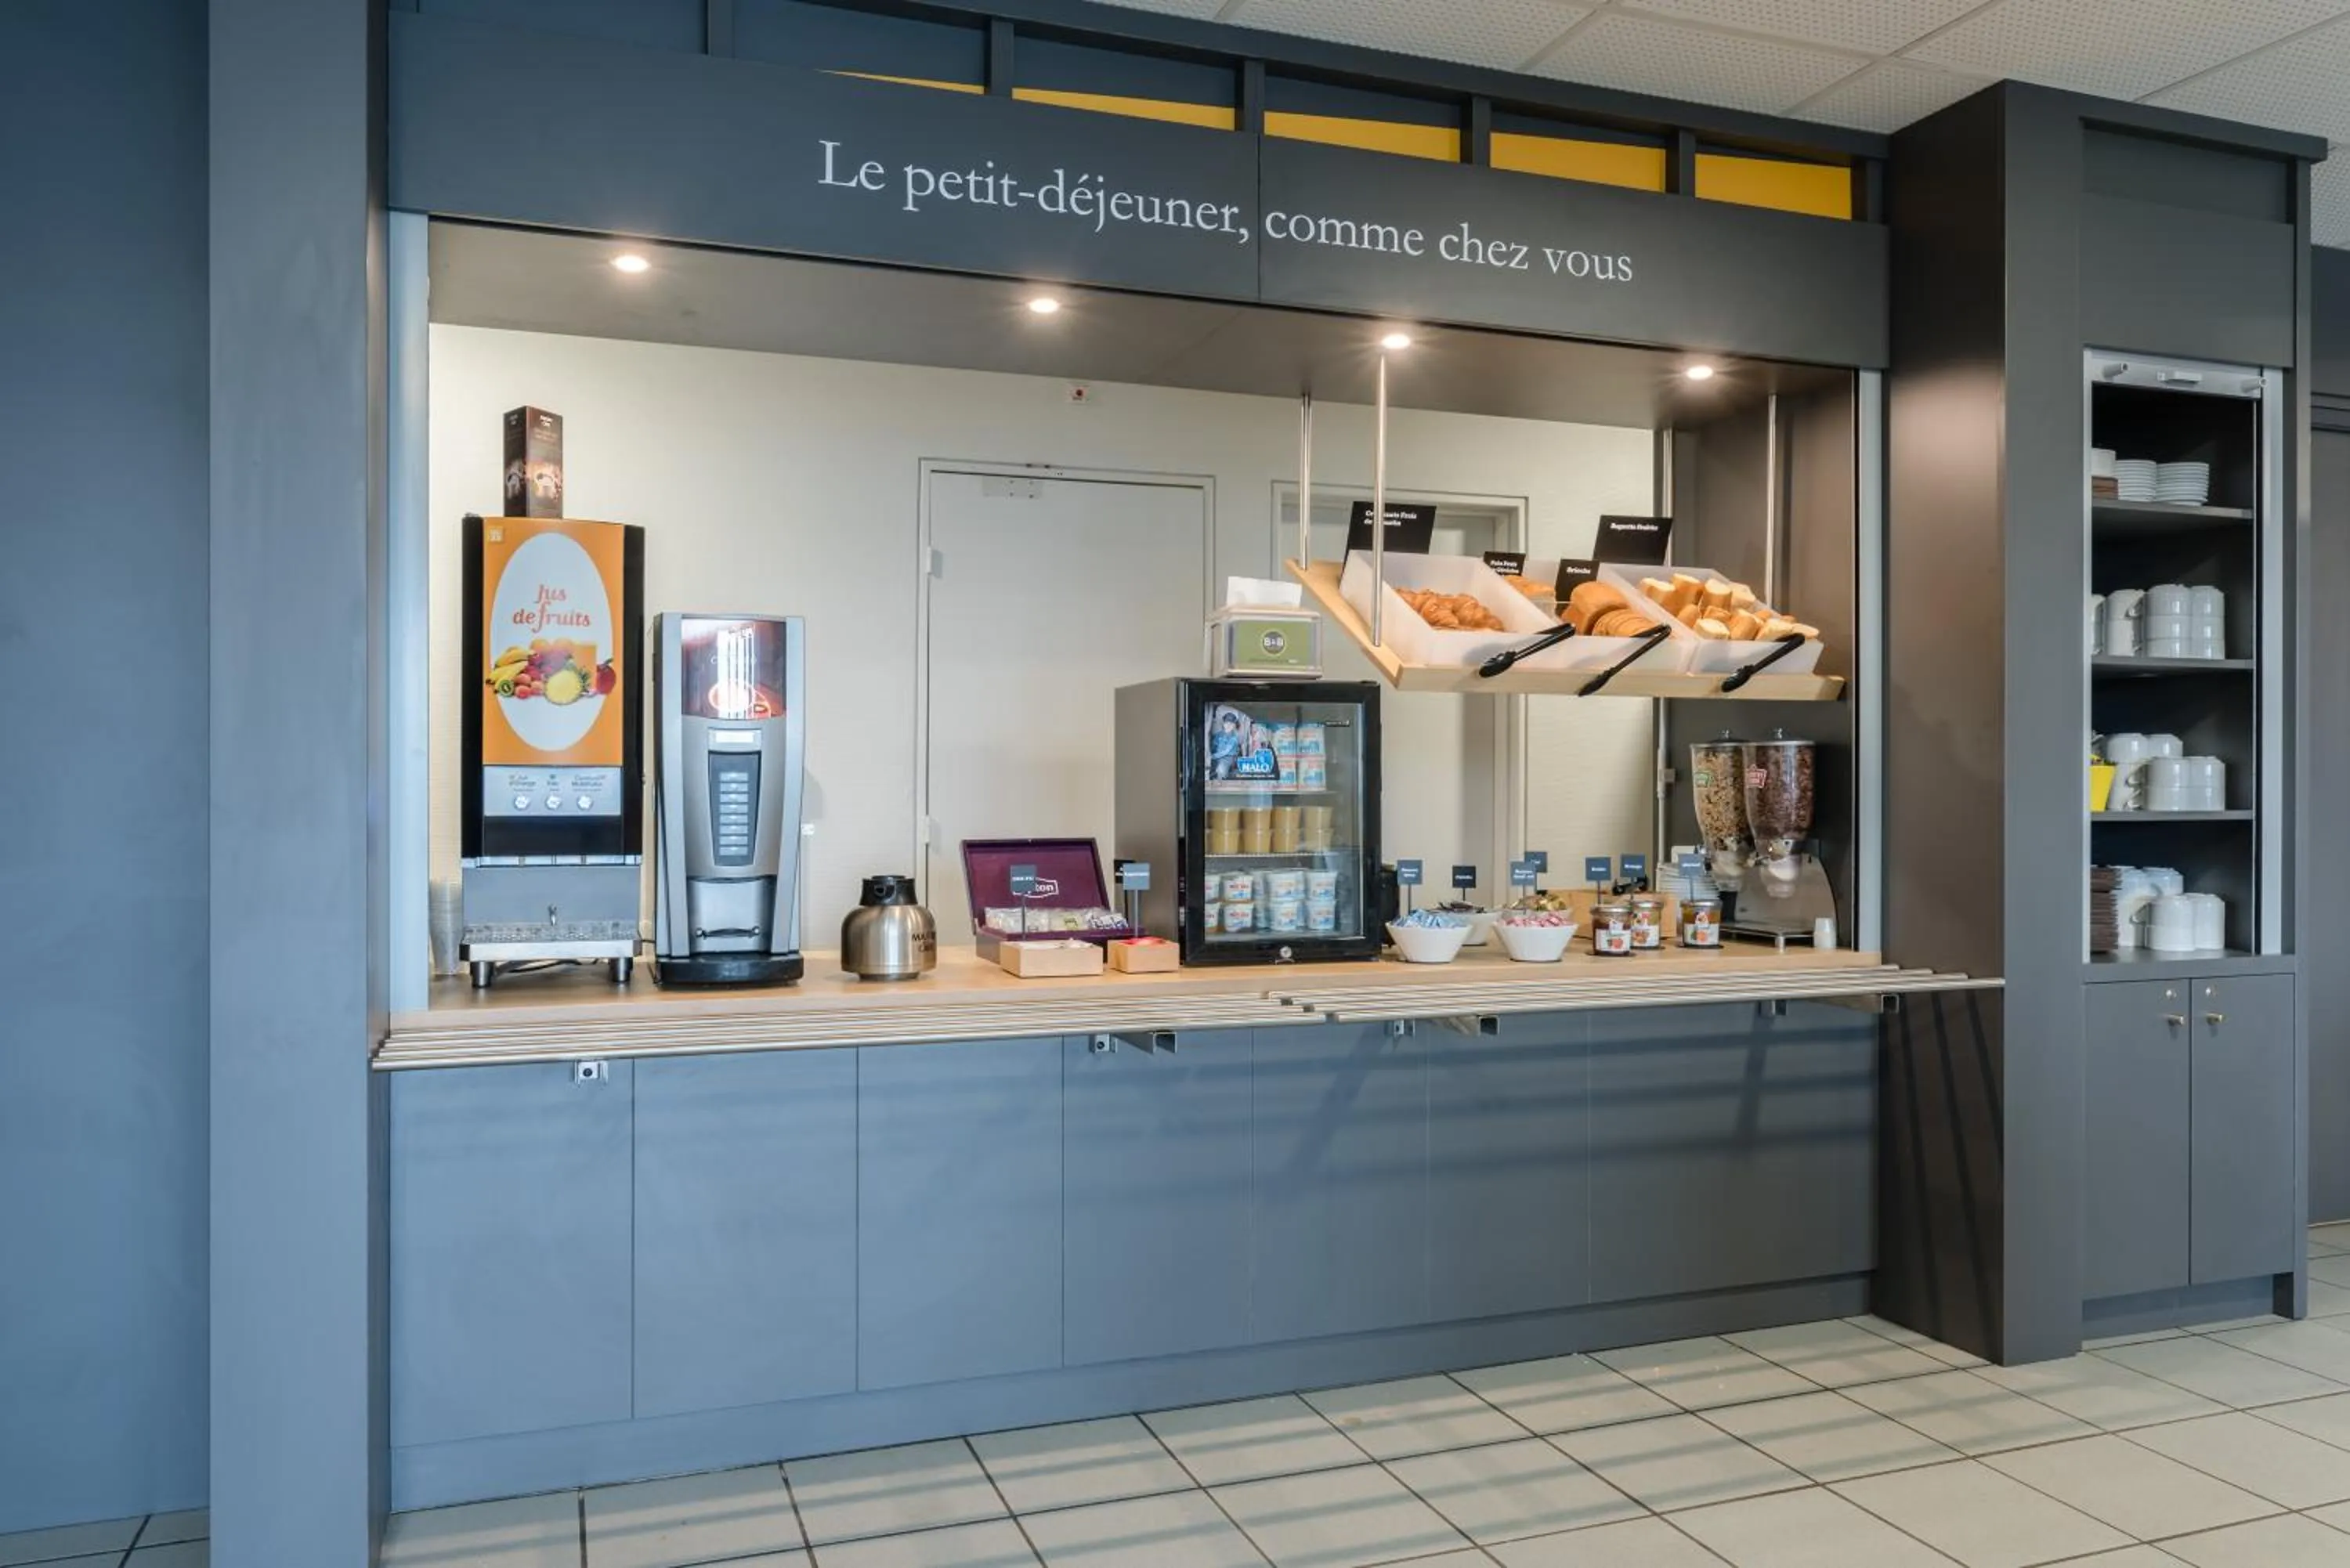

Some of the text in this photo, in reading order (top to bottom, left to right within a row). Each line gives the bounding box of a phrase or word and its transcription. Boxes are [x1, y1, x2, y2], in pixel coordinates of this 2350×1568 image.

[817, 139, 1634, 282] Le petit-déjeuner, comme chez vous
[533, 584, 566, 605] Jus
[512, 600, 591, 634] de fruits
